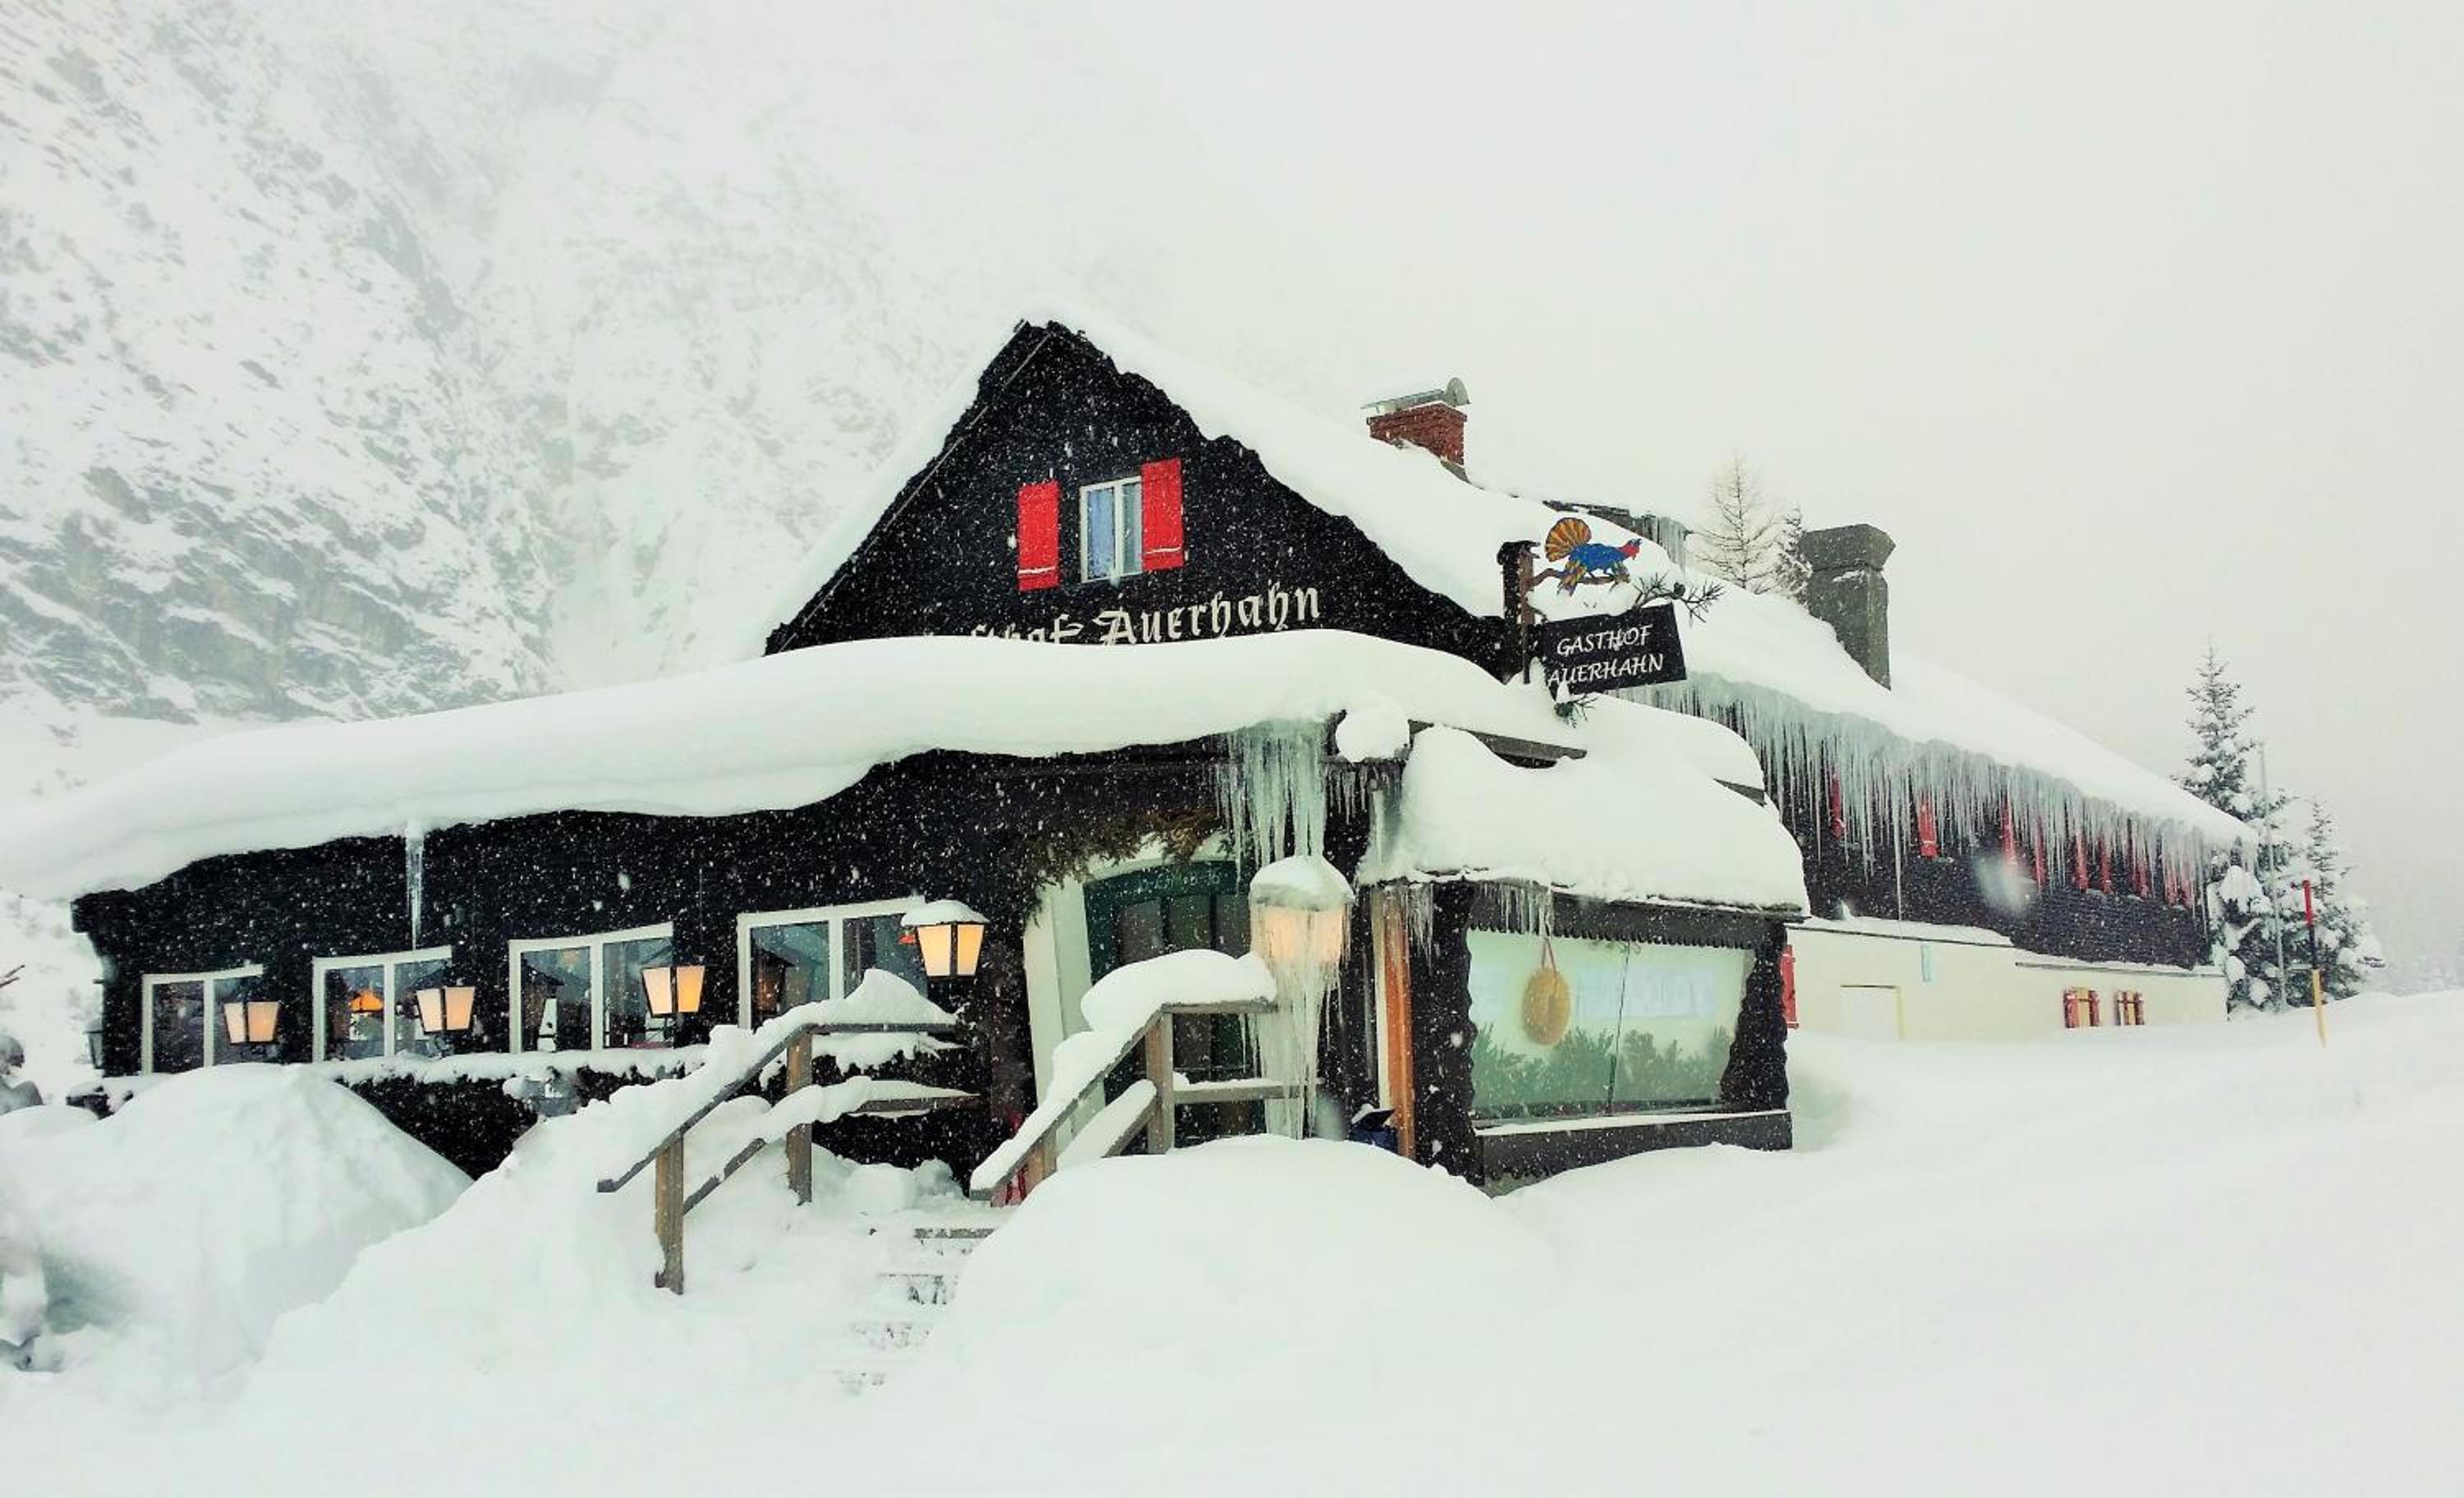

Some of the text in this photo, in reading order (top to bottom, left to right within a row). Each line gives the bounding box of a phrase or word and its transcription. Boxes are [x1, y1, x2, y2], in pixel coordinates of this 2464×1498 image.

[1092, 579, 1320, 646] Auerhahn
[1556, 624, 1653, 656] GASTHOF
[1547, 654, 1663, 685] AUERHAHN
